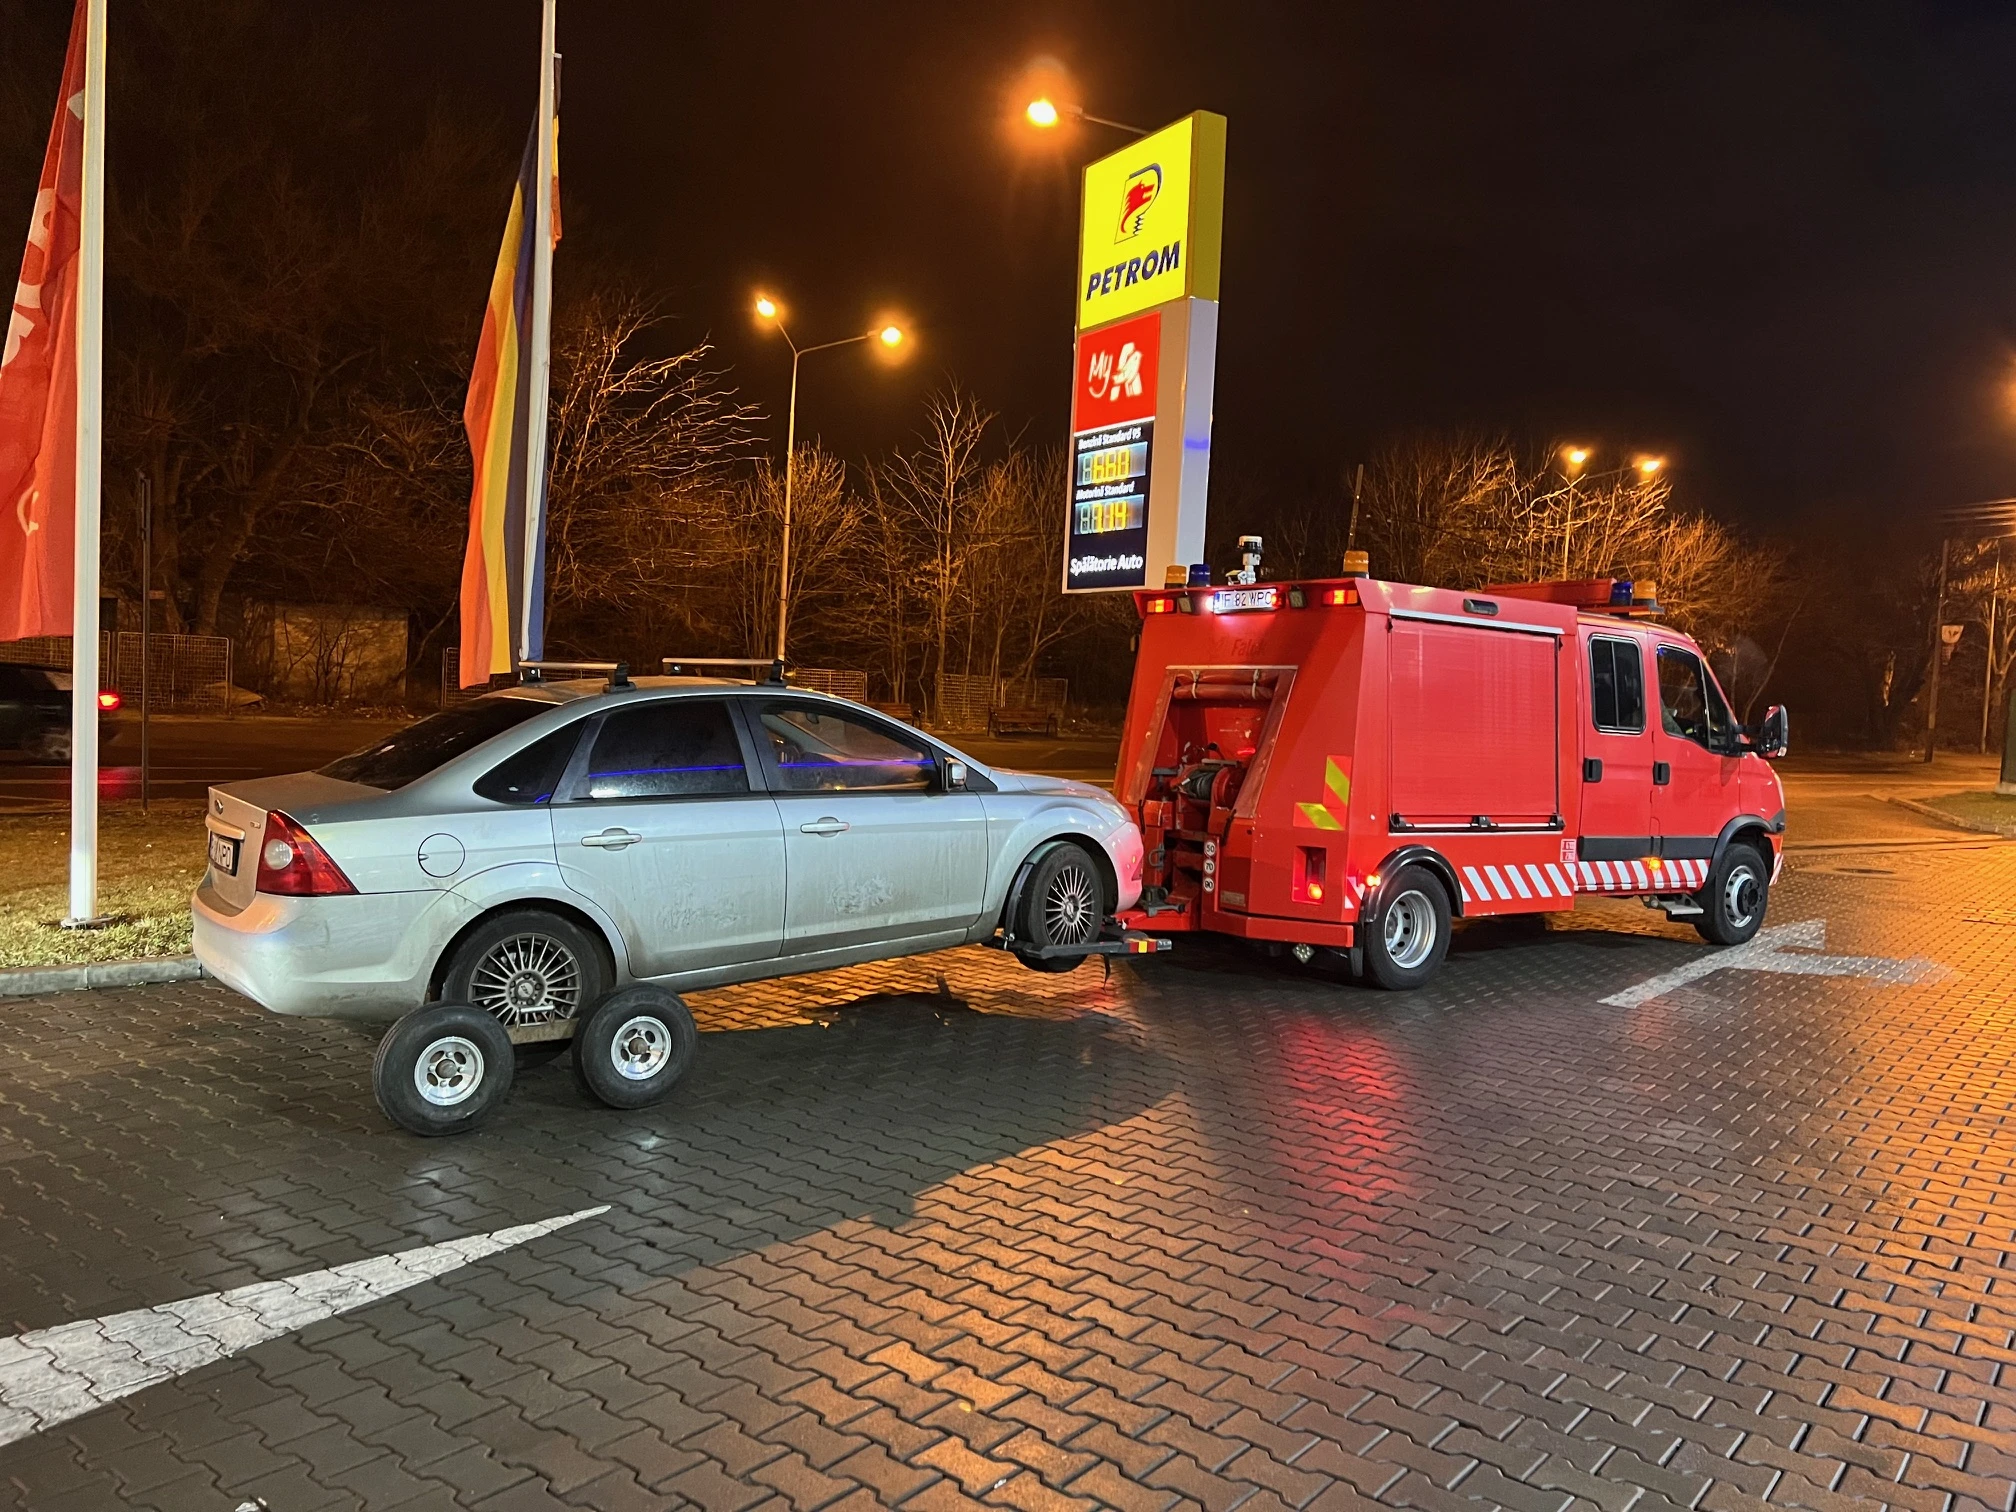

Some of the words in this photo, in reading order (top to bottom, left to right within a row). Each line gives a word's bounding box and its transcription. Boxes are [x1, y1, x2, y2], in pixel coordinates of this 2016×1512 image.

[1086, 240, 1180, 301] PETROM
[1117, 554, 1144, 570] Auto
[1235, 592, 1247, 607] 82
